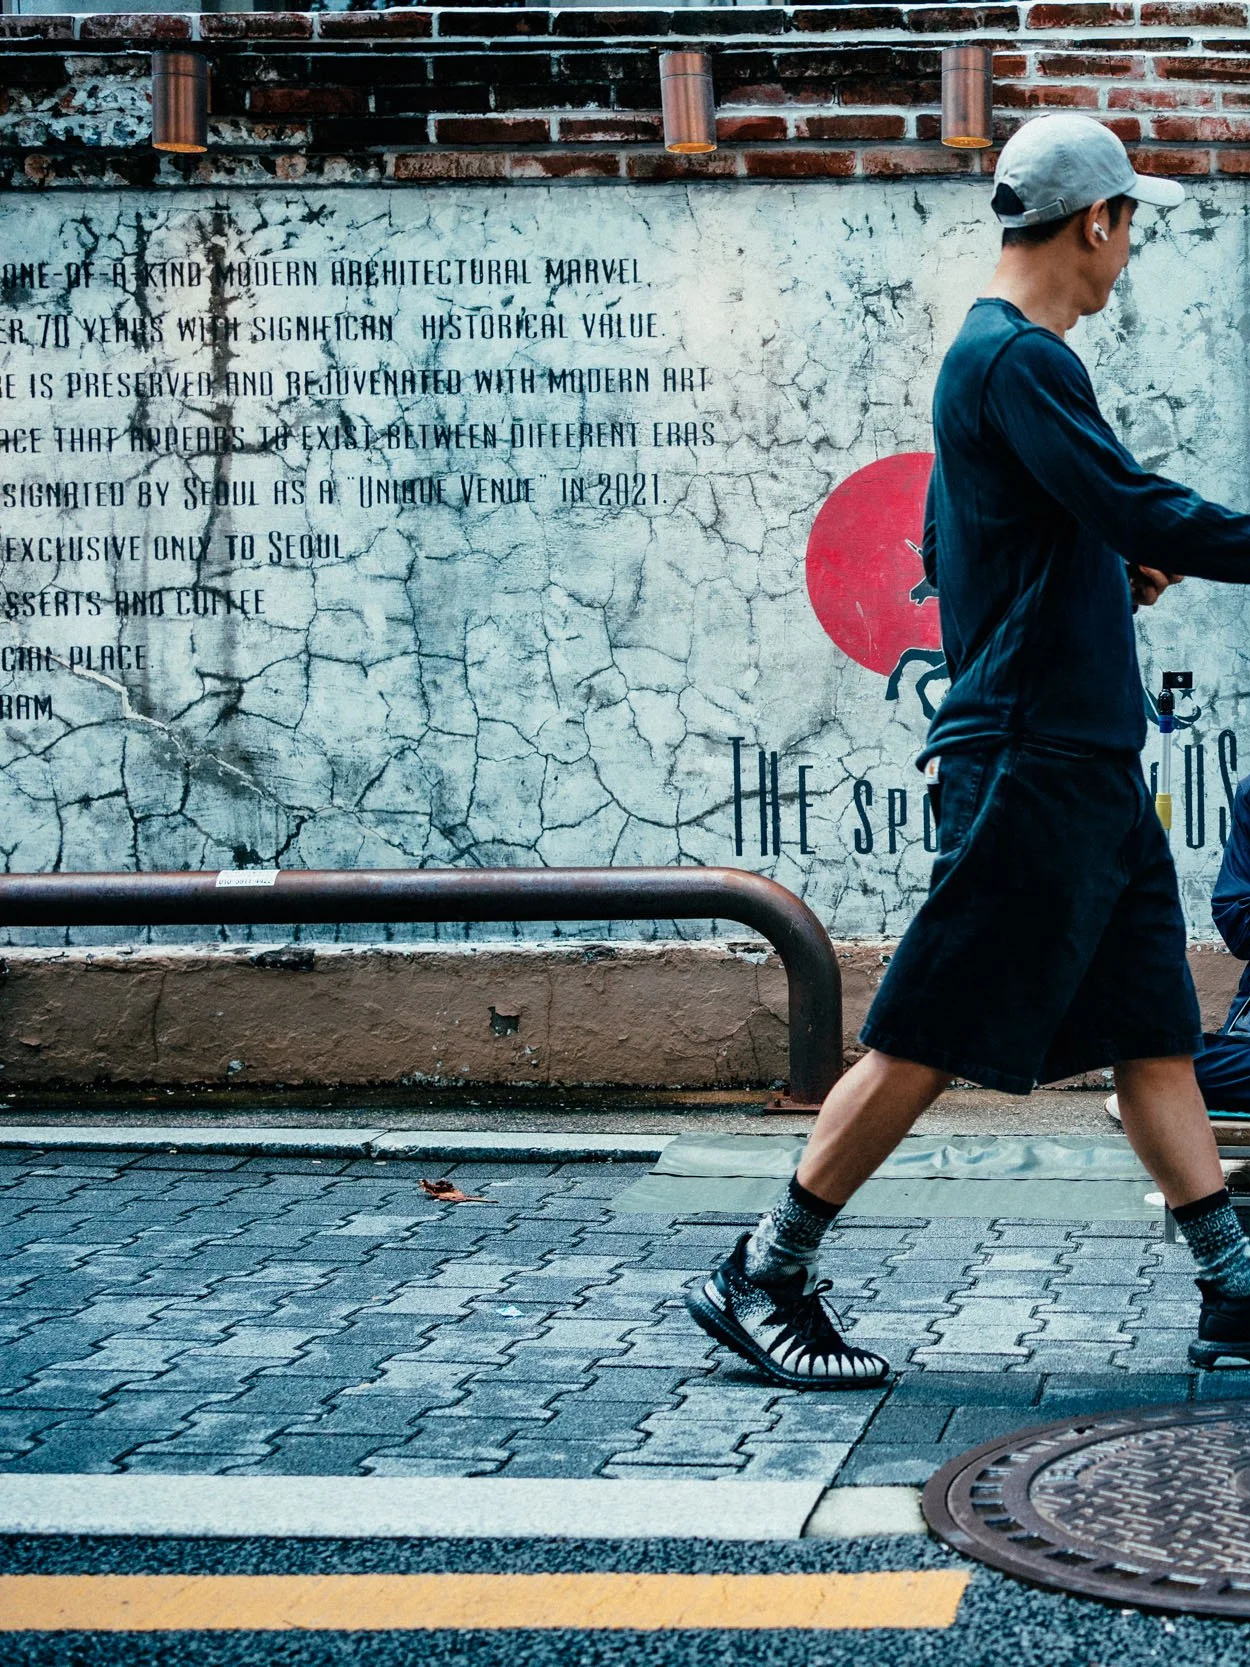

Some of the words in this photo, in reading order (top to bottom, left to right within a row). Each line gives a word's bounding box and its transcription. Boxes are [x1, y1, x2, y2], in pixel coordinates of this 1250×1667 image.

[216, 261, 317, 287] MODERN
[332, 259, 531, 287] ARCHITECTURAL
[37, 314, 69, 348] 70
[84, 316, 163, 344] YEARS
[178, 316, 238, 343] WITH
[422, 313, 568, 340] HISTORICAL
[582, 313, 665, 339] VALUE.
[30, 373, 53, 399] IS
[67, 371, 211, 398] PRESERVED
[225, 370, 273, 397] AND
[287, 369, 461, 397] REJUVENATED
[475, 368, 535, 395] WITH
[550, 367, 649, 394] MODERN
[663, 367, 710, 393] ART
[53, 427, 117, 452] THAT
[130, 426, 245, 452] APPEARS
[259, 427, 288, 451] TO
[302, 425, 373, 450] EXIST
[388, 424, 497, 450] BETWEEN
[511, 423, 641, 449] DIFFERENT
[653, 422, 715, 448] ERAS
[3, 482, 124, 508] SIGNATED
[138, 481, 169, 507] BY
[184, 478, 259, 510] SEOUL
[274, 480, 305, 505] AS
[320, 480, 334, 505] A
[562, 477, 584, 503] IN
[600, 472, 667, 506] 2021.
[6, 536, 141, 563] EXCLUSIVE
[154, 535, 211, 561] ONLY
[225, 535, 254, 561] TO
[268, 530, 345, 563] SEOUL
[115, 590, 164, 617] AND
[177, 589, 266, 616] COFFEE
[70, 645, 154, 671] PLACE.
[727, 736, 816, 857] THE
